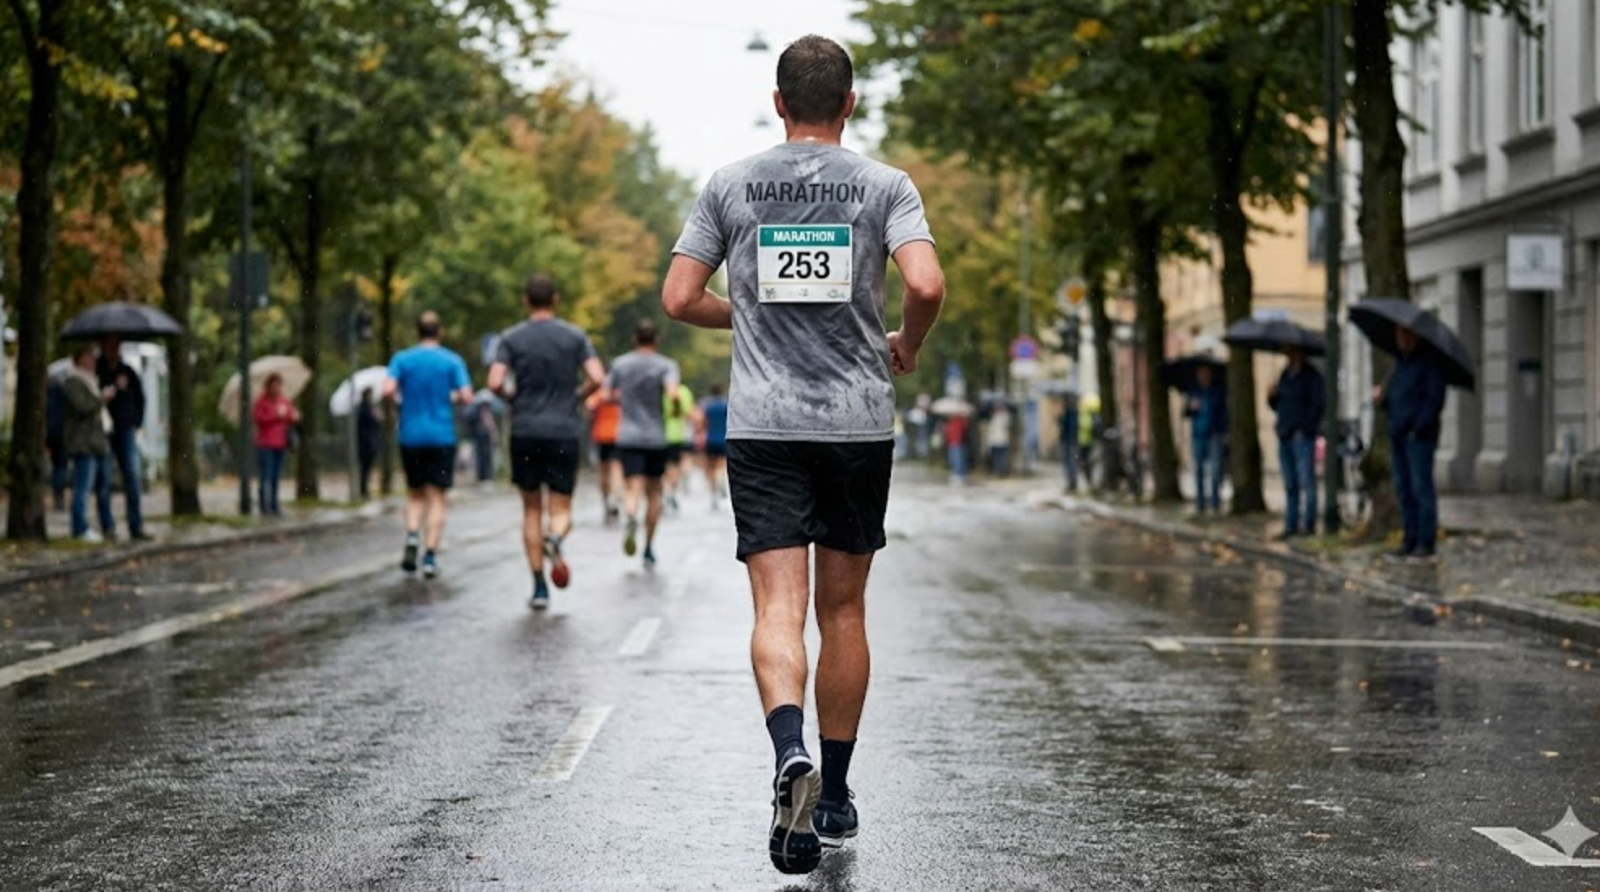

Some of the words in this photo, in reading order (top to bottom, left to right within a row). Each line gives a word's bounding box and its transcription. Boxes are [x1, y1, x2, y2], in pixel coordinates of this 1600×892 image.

[745, 181, 866, 204] MARATHON
[773, 231, 835, 242] MARATHON
[778, 251, 831, 279] 253
